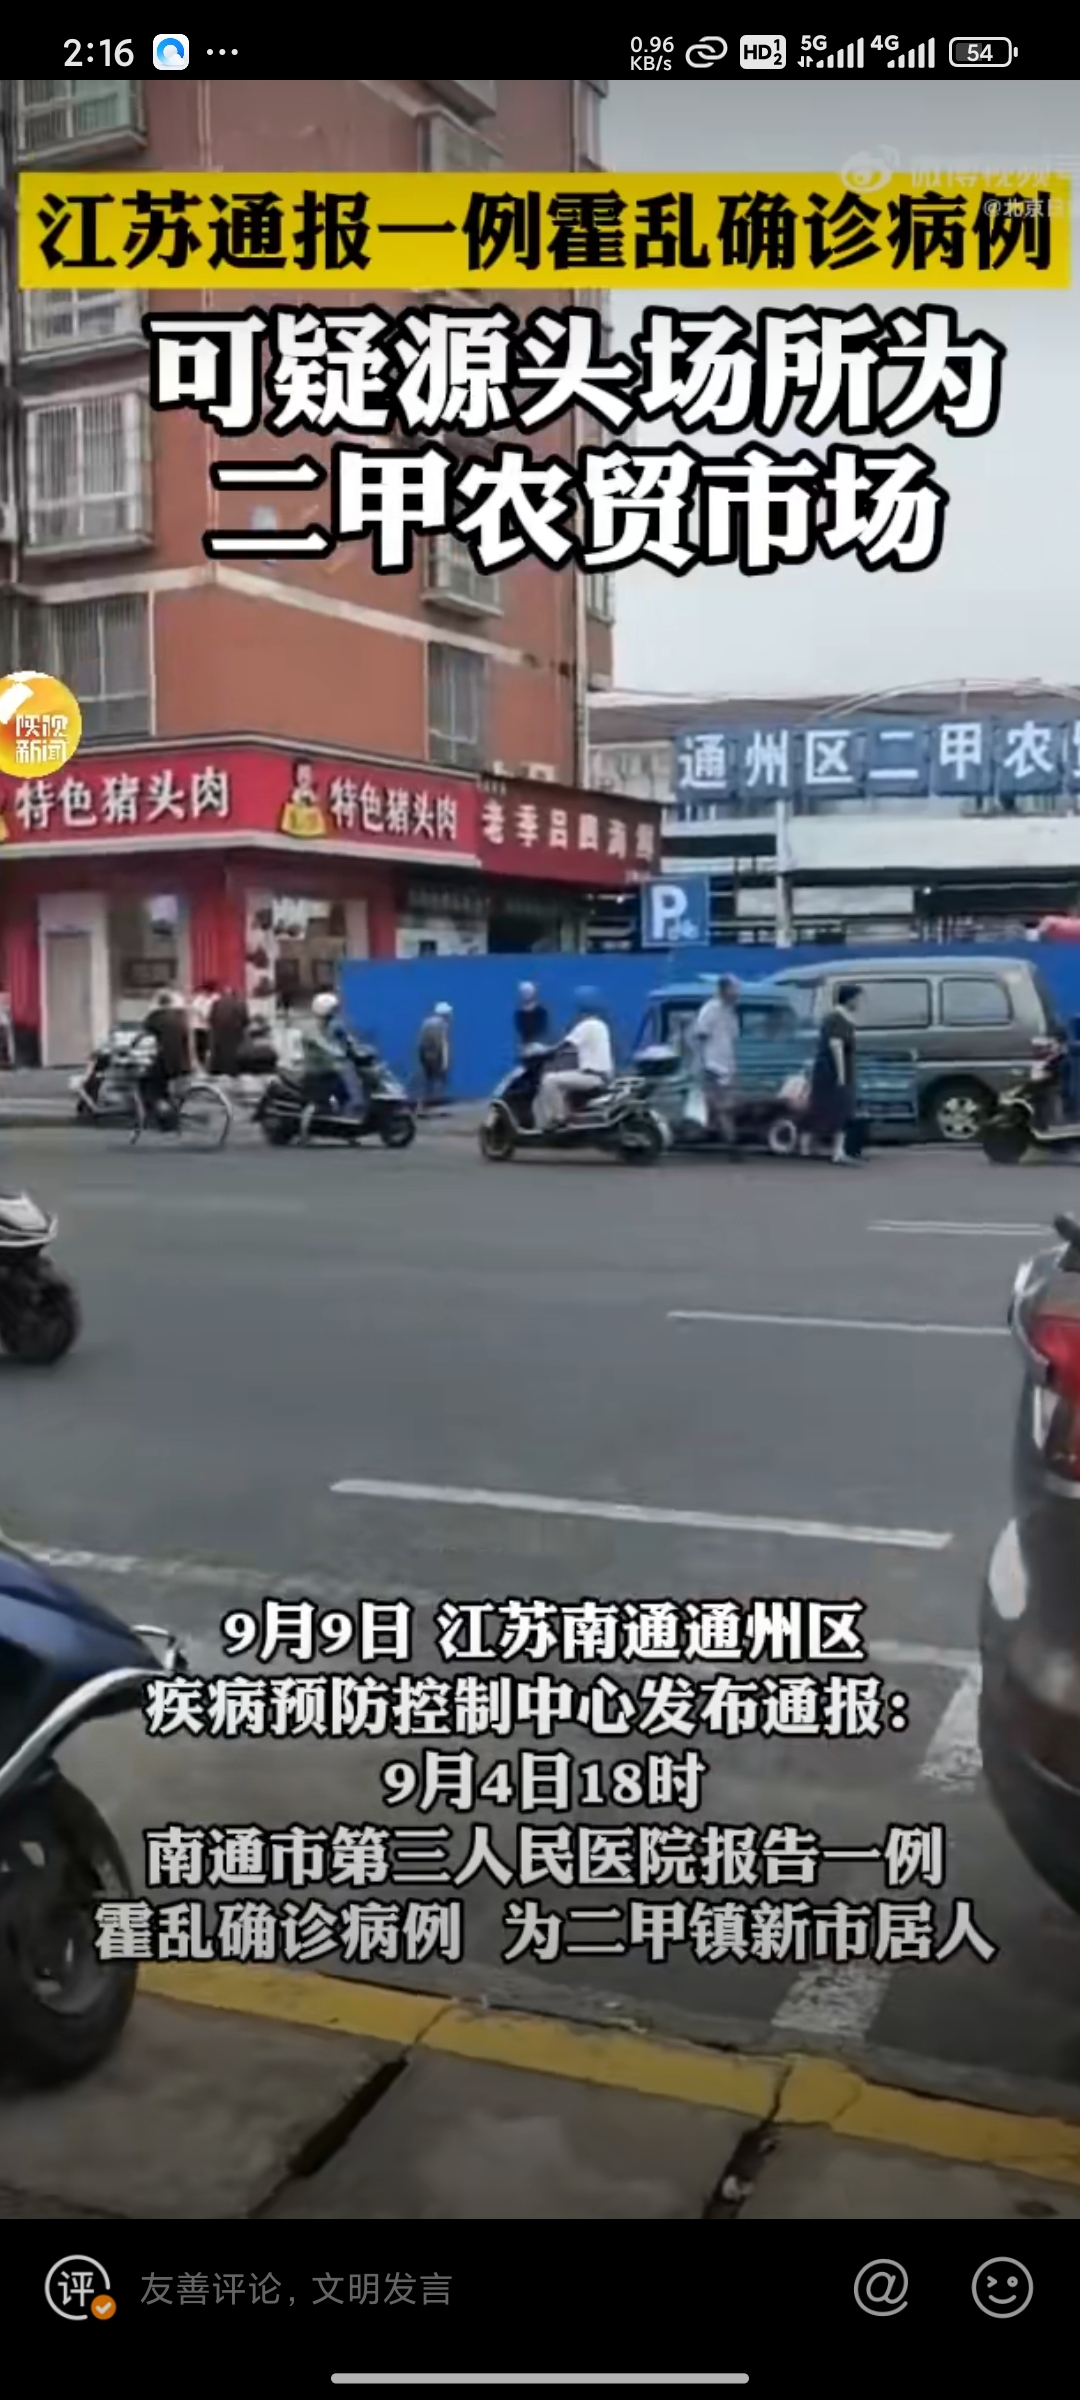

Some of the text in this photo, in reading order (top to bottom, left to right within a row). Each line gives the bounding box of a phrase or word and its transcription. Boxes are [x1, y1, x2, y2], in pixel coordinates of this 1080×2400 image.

[14, 765, 230, 830] 特色猪头肉
[330, 776, 457, 840] 特色猪头肉
[650, 885, 688, 939] P
